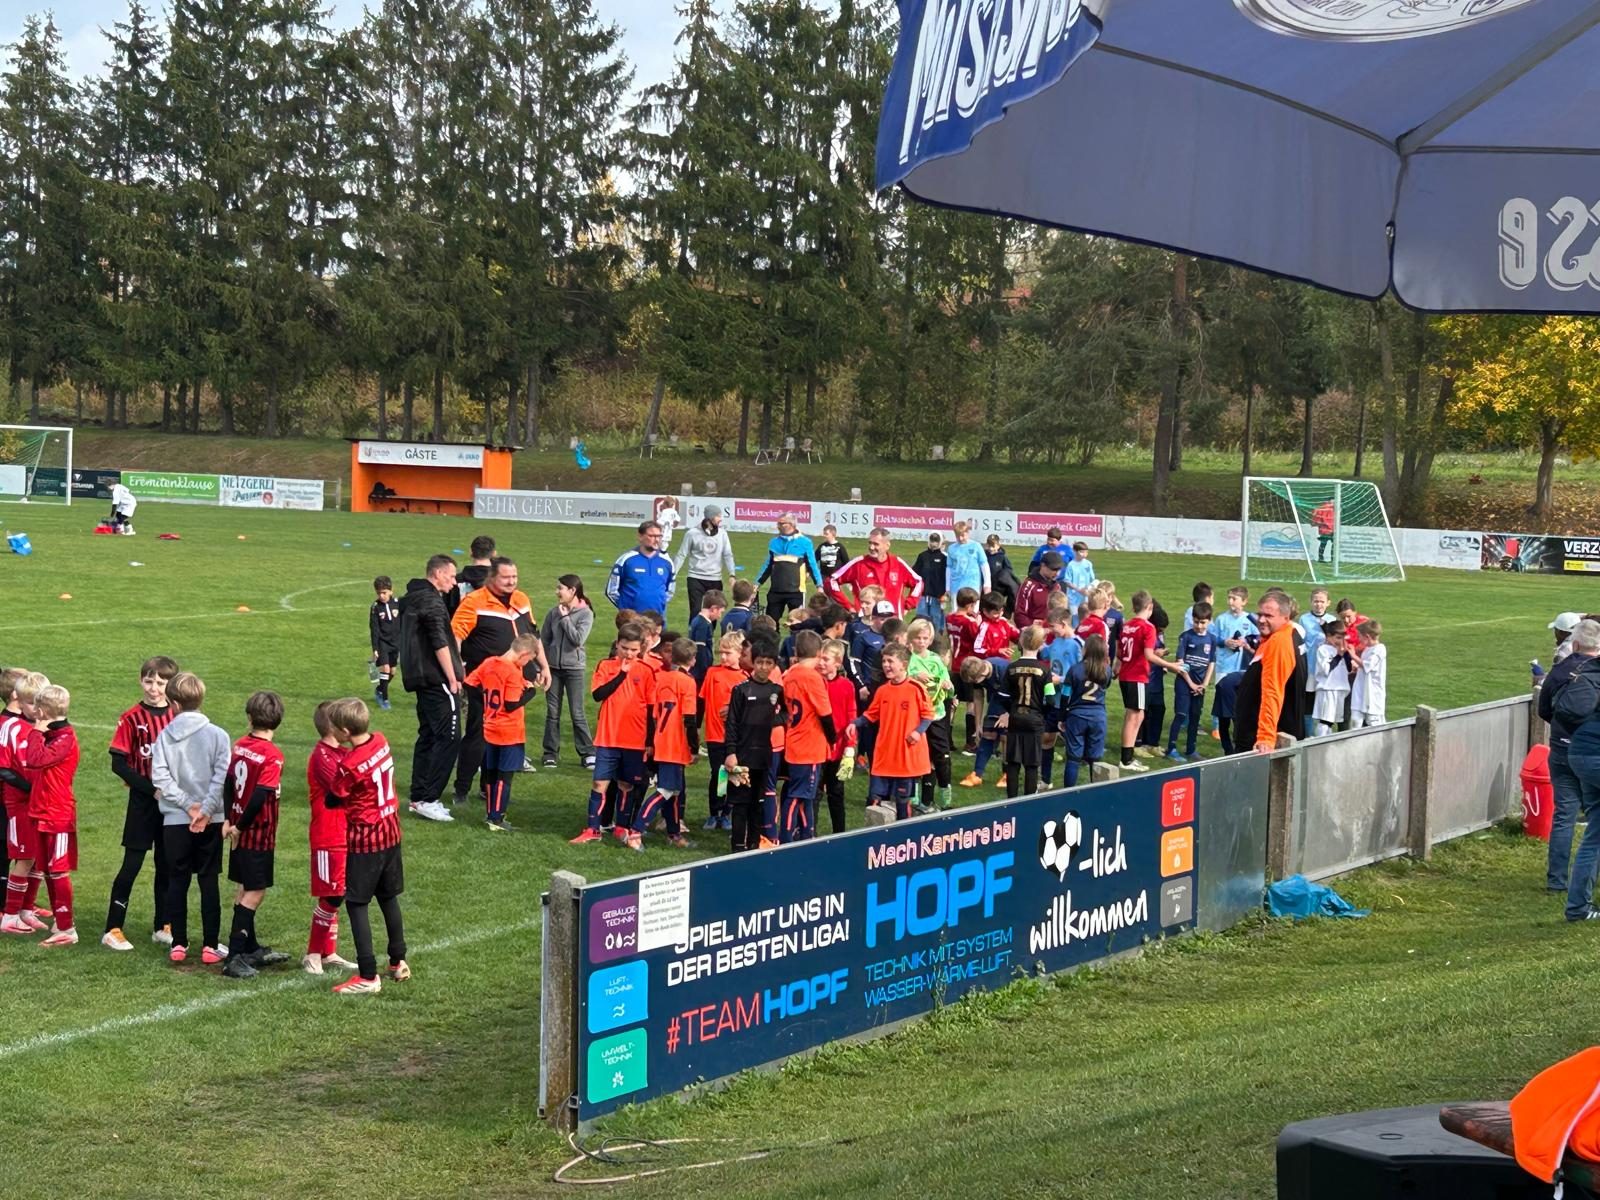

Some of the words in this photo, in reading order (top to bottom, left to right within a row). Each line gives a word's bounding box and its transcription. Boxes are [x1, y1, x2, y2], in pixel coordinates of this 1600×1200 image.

[404, 449, 438, 460] GÄSTE
[129, 475, 214, 491] Eremitenklause
[221, 476, 274, 490] METZGEREI
[477, 495, 517, 514] SEHR
[521, 497, 574, 516] GERNE
[875, 514, 926, 525] Elektrotechnik
[928, 516, 953, 526] GmbH
[1075, 522, 1101, 533] GmbH
[1563, 540, 1600, 554] VERZ
[1081, 680, 1099, 700] 2
[868, 838, 917, 870] Mach
[920, 826, 991, 859] Karriere
[993, 816, 1016, 843] bei
[865, 851, 1015, 949] HOPF
[737, 908, 776, 939] MIT
[779, 896, 821, 929] UNS
[825, 891, 845, 918] IN
[1030, 889, 1148, 955] willkommen
[667, 953, 712, 987] DER
[716, 932, 798, 974] BESTEN
[802, 918, 850, 952] LIGA!
[864, 949, 926, 982] TECHNIK
[928, 942, 955, 965] MIT
[956, 926, 1013, 958] SYSTEM
